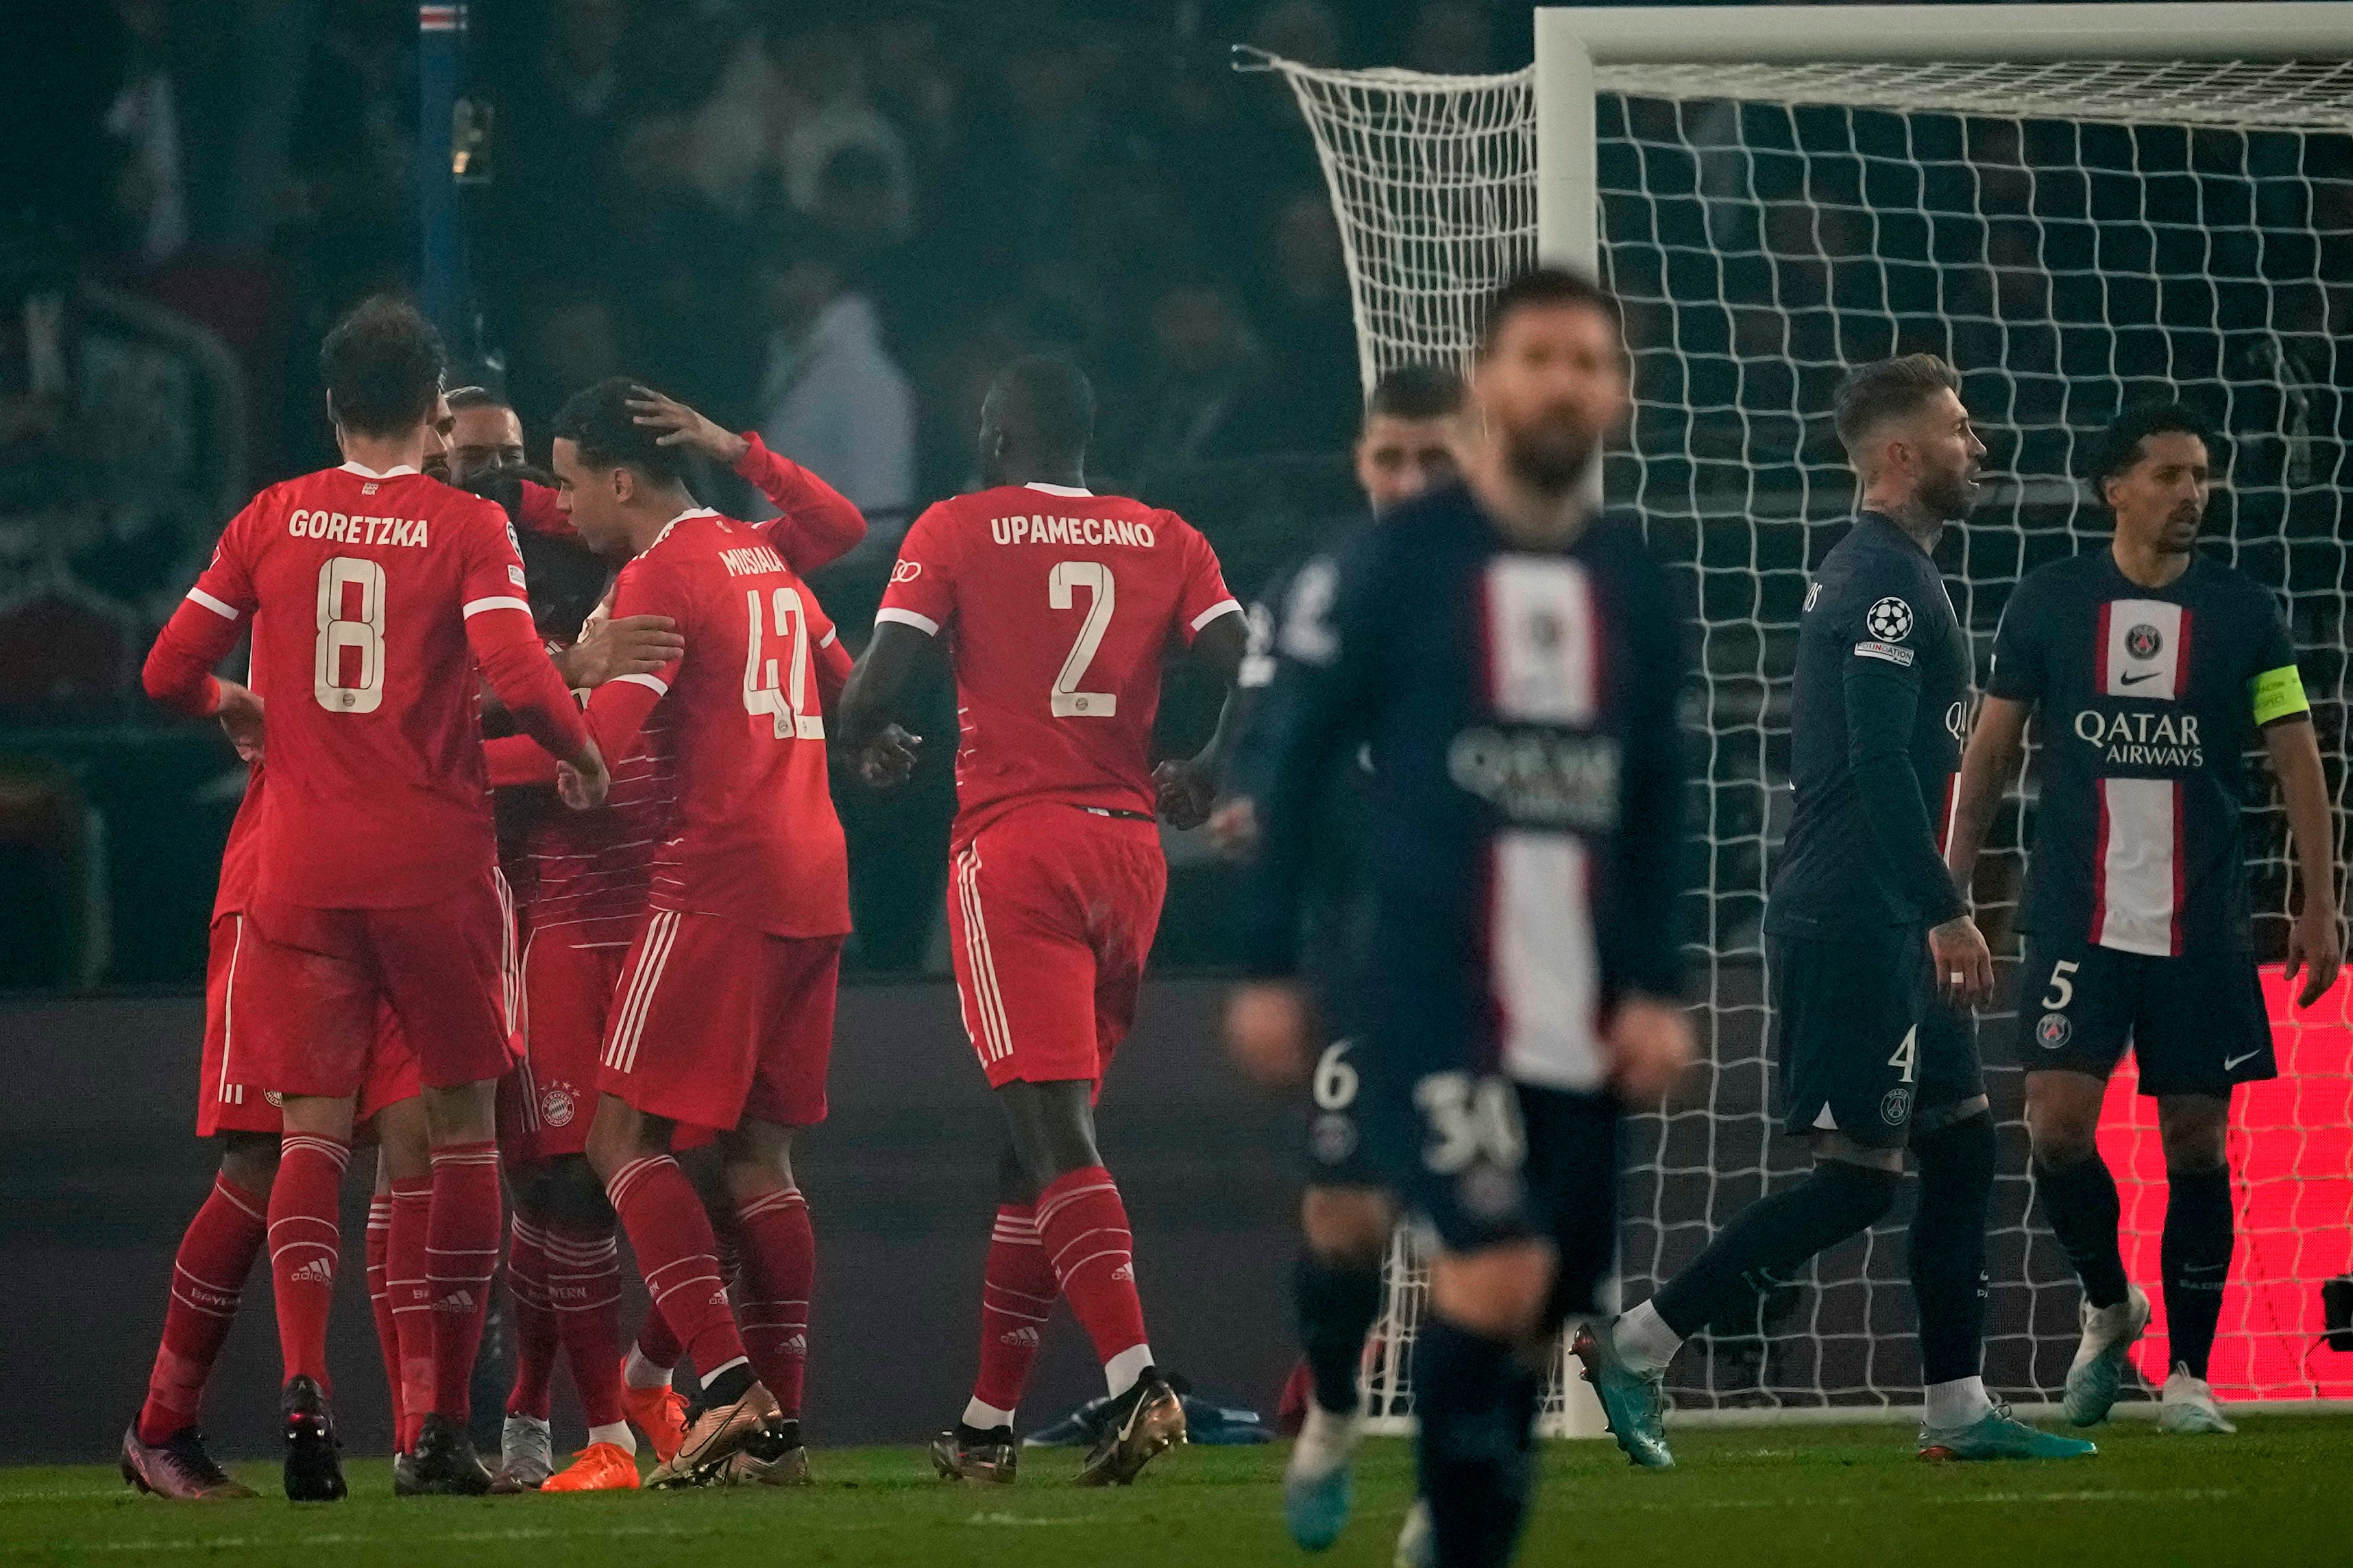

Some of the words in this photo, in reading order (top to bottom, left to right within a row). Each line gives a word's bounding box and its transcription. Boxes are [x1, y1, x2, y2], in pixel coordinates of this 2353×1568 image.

[289, 509, 428, 548] GORETZKA
[991, 515, 1155, 547] UPAMECANO
[718, 546, 786, 577] MUSIALA
[315, 556, 386, 713] 8
[1049, 561, 1117, 717] 2
[1857, 642, 1912, 661] FOUNDATION
[743, 587, 825, 739] 42
[2074, 710, 2201, 748] QATAR
[2105, 744, 2204, 767] AIRWAYS
[2042, 959, 2080, 1010] 5
[1313, 1038, 1360, 1110] 6
[1888, 1023, 1918, 1083] 4
